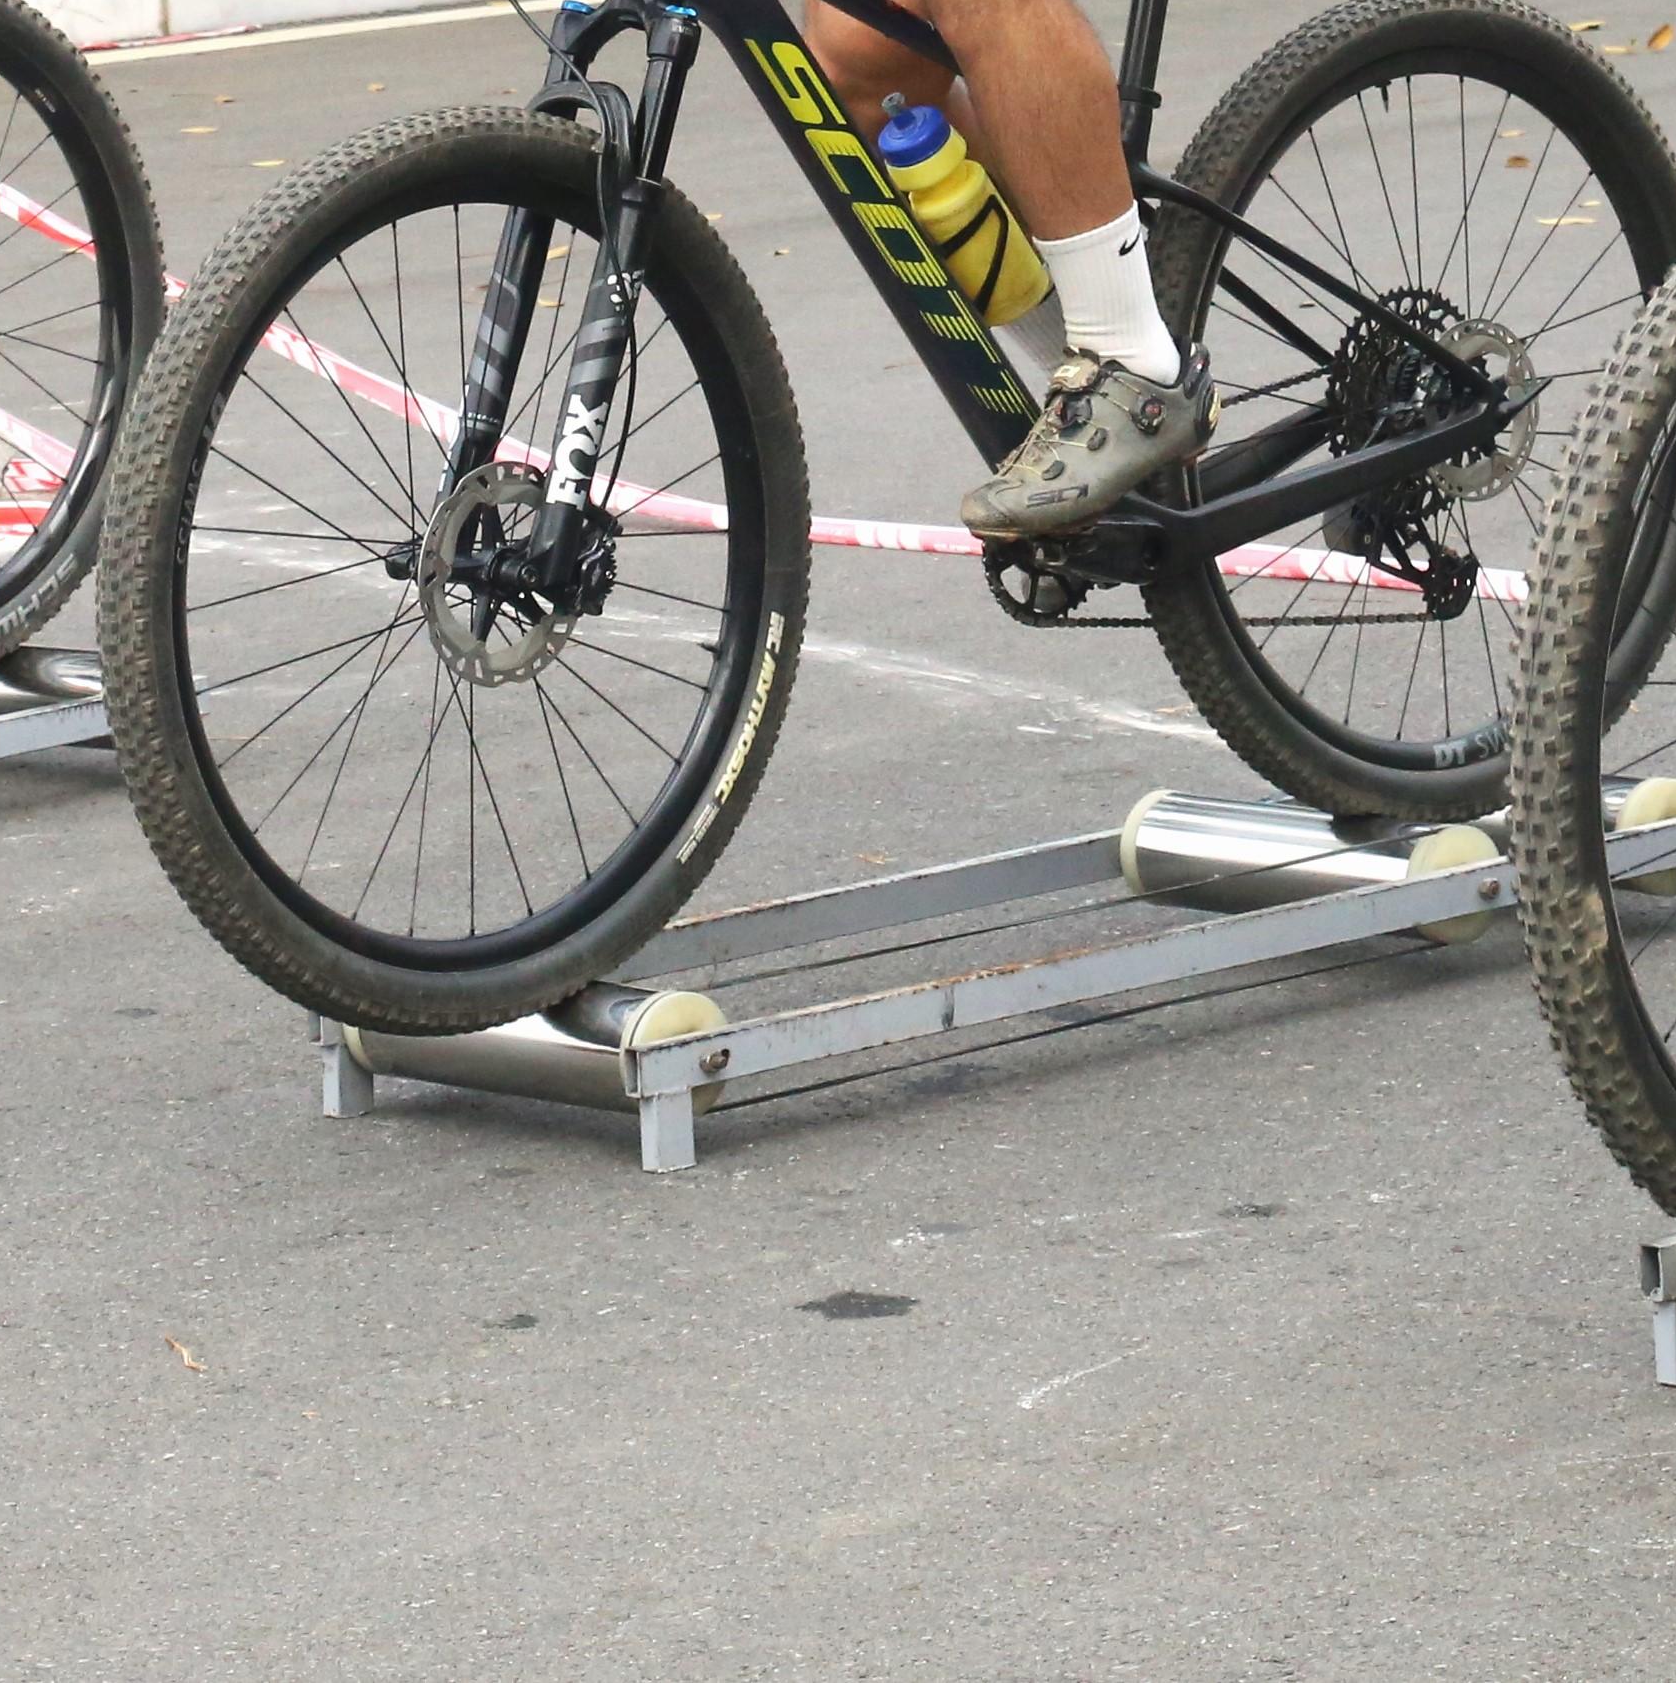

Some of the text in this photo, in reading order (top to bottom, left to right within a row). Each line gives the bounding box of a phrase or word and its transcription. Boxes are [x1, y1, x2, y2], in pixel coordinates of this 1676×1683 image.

[744, 37, 1043, 426] SCOTT
[545, 393, 609, 512] FOX
[1432, 738, 1467, 769] DT
